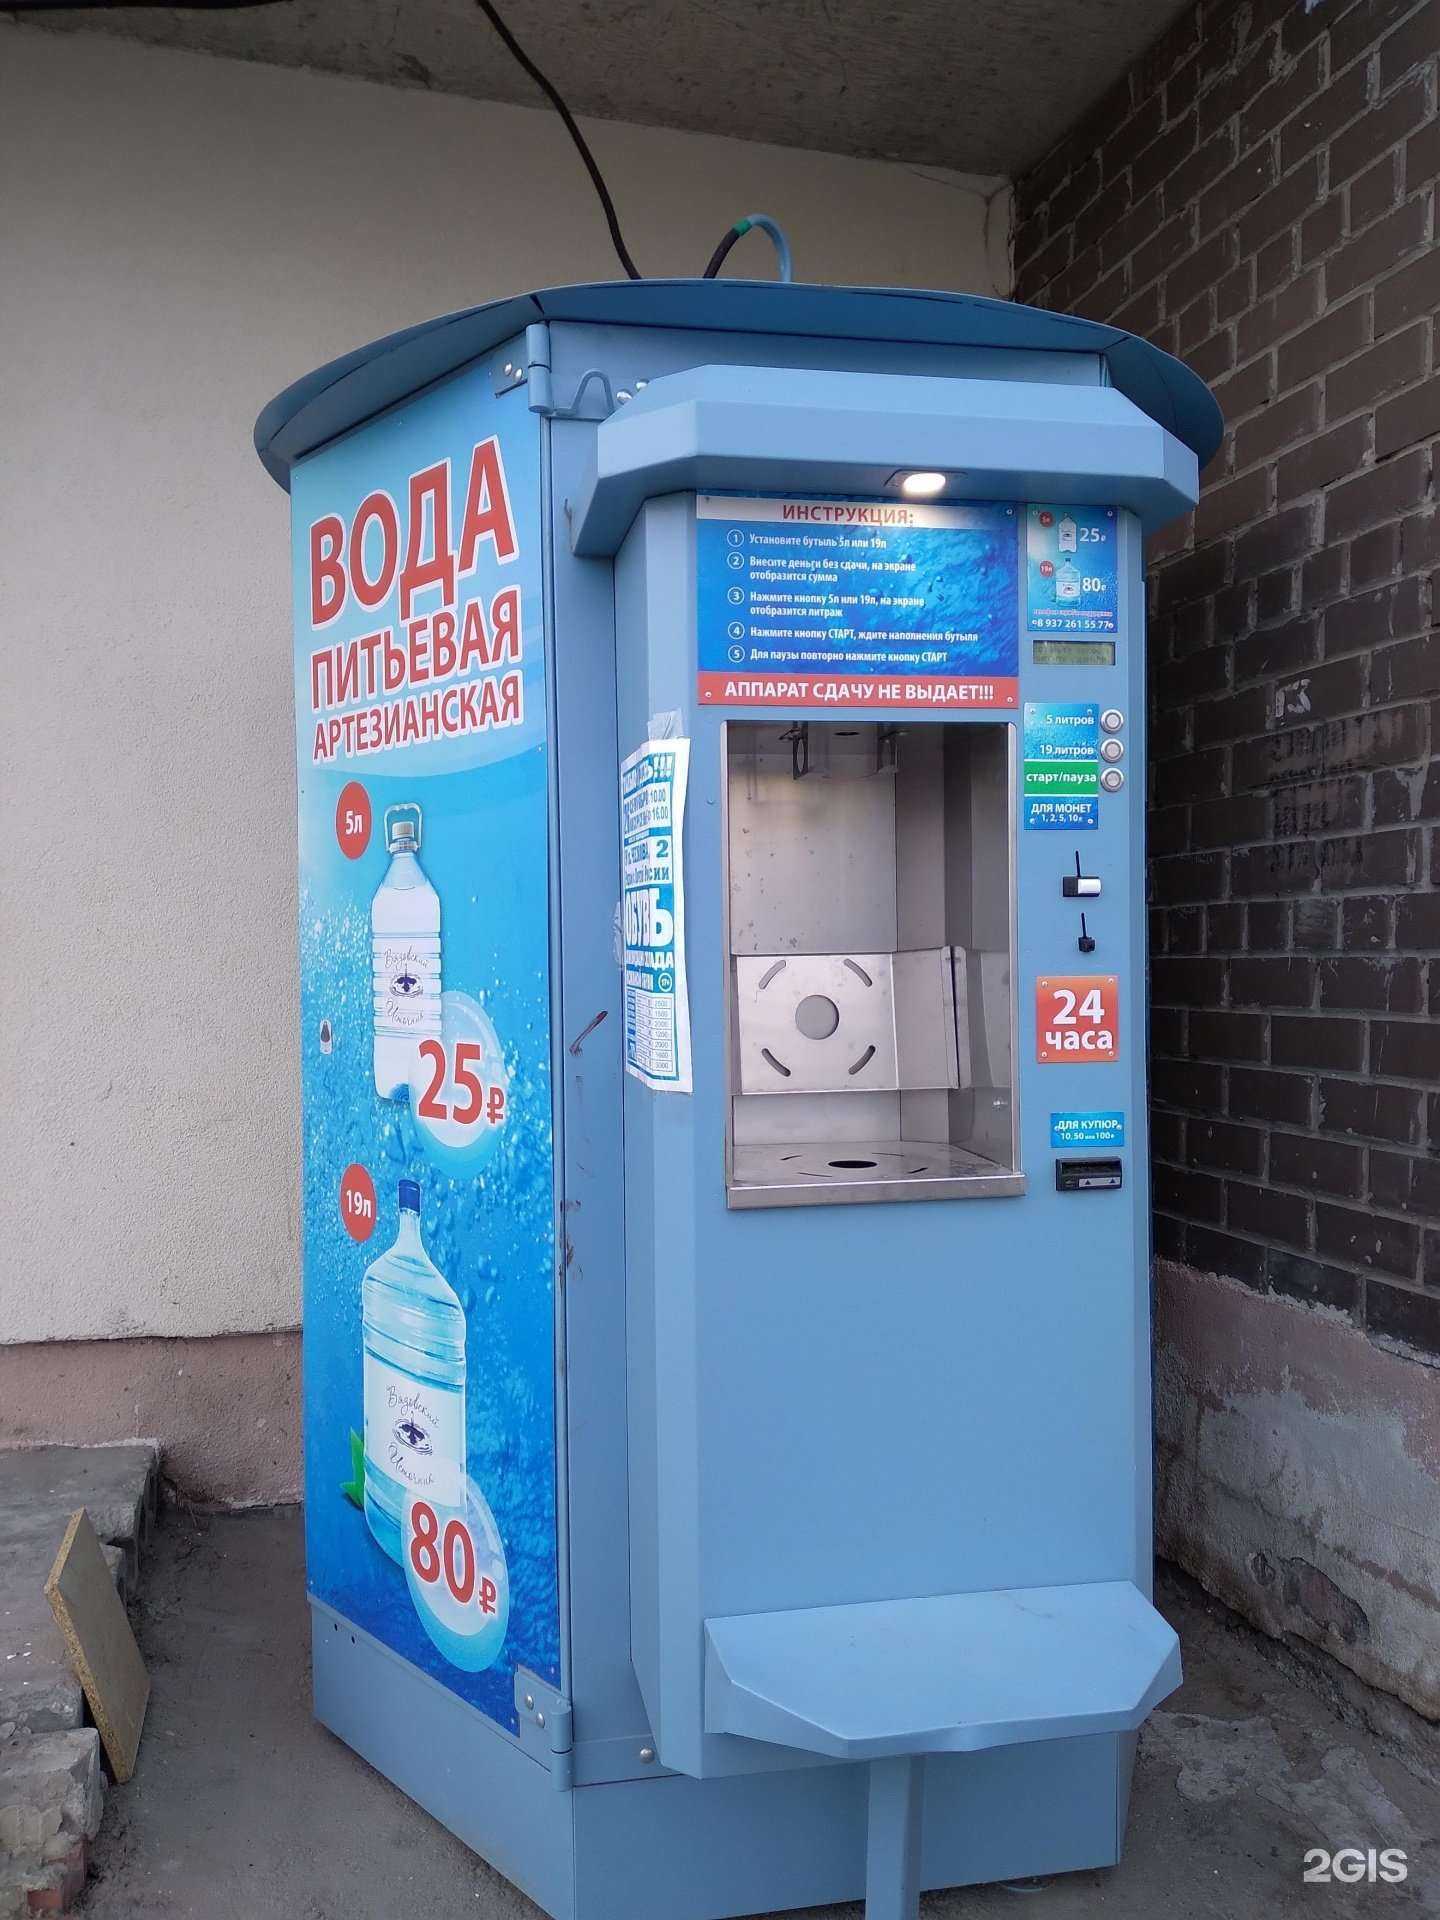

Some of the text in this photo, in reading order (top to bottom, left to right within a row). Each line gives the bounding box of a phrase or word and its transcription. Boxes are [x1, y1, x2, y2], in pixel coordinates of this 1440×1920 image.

[782, 504, 914, 526] ИНСТРУКЦИЯ:
[309, 434, 520, 630] ВОДА
[750, 533, 801, 546] Установите
[802, 535, 837, 549] бутыль
[838, 536, 850, 547] 5л
[852, 539, 869, 548] или
[871, 538, 887, 549] 19л
[749, 556, 787, 568] Внесите
[788, 559, 821, 571] деньги
[822, 558, 839, 570] без
[840, 560, 870, 571] сдачи,
[871, 562, 882, 571] на
[884, 563, 916, 573] экране
[750, 569, 838, 583] отобразится сумма
[750, 591, 793, 603] Нажмите
[794, 595, 827, 606] кнопку
[828, 593, 840, 604] 5л
[841, 595, 858, 604] или
[860, 594, 879, 606] 19л,
[880, 597, 892, 605] на
[893, 597, 925, 607] экране
[750, 604, 843, 618] отобразится литраж
[1045, 620, 1063, 629] 937
[1065, 620, 1082, 629] 261
[1084, 621, 1096, 629] 55
[1097, 621, 1109, 630] 77
[750, 627, 793, 638] Нажмите
[794, 630, 827, 640] кнопку
[828, 629, 857, 640] СТАРТ,
[858, 631, 888, 640] ждите
[889, 632, 943, 641] наполнения
[944, 631, 978, 644] бутыля
[310, 586, 522, 712] ПИТЬЕВАЯ
[750, 648, 769, 660] Для
[770, 652, 800, 662] паузы
[801, 652, 844, 663] повторно
[845, 654, 887, 662] нажмите
[888, 653, 920, 665] кнопку
[921, 652, 948, 663] СТАРТ
[724, 681, 994, 703] АППАРАТ СДАЧУ НЕ ВЫДАЕТ!!!
[311, 670, 524, 765] АРТЕЗИАНСКАЯ
[1046, 715, 1094, 727] 5 литров
[1040, 745, 1094, 757] 19 литров
[1026, 772, 1097, 784] старт/пауза
[1031, 803, 1092, 814] ДЛЯ МОНЕТ
[345, 810, 362, 835] 5л
[625, 886, 674, 947] ОБУВЬ
[1053, 989, 1105, 1025] 24
[1045, 1030, 1113, 1050] часа
[418, 1039, 505, 1126] 25₽
[1058, 1120, 1118, 1131] ДЛЯ КУПЮР
[346, 1190, 371, 1219] 19л
[410, 1501, 497, 1615] 80₽
